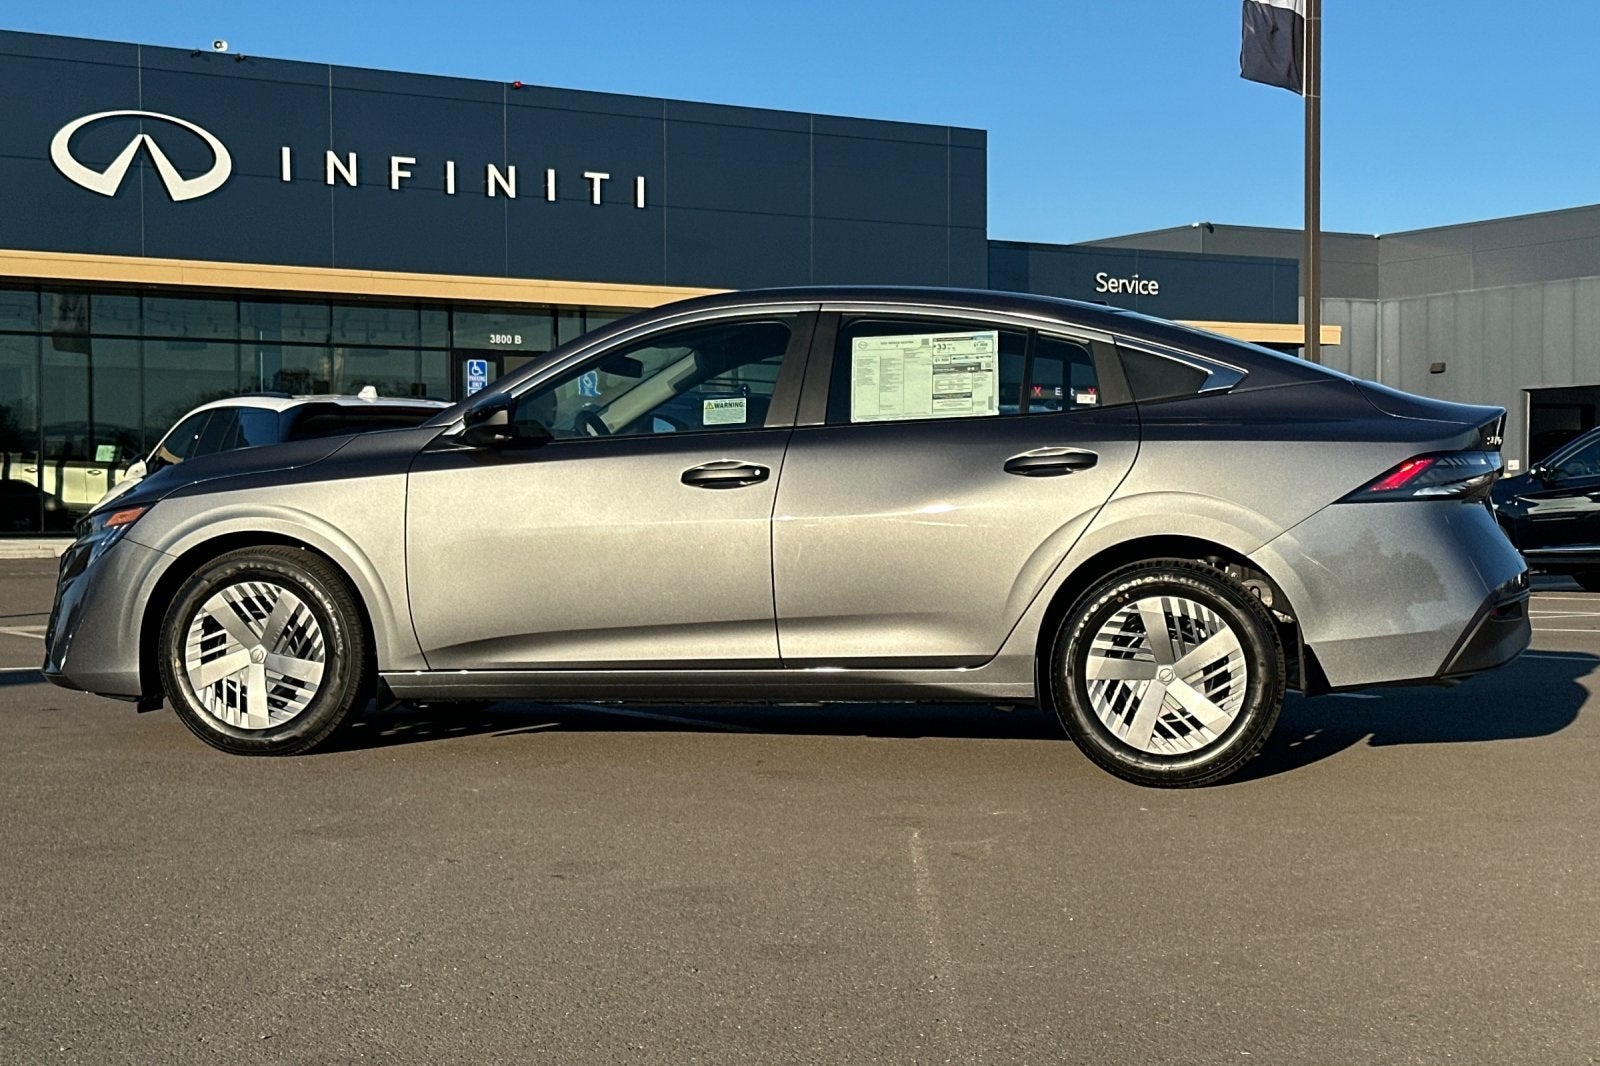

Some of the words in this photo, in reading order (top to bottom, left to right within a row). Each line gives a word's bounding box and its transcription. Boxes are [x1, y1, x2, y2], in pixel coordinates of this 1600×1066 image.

[281, 146, 645, 208] INFINITI
[1095, 272, 1159, 295] Service
[490, 334, 512, 344] 3800
[514, 335, 522, 344] B
